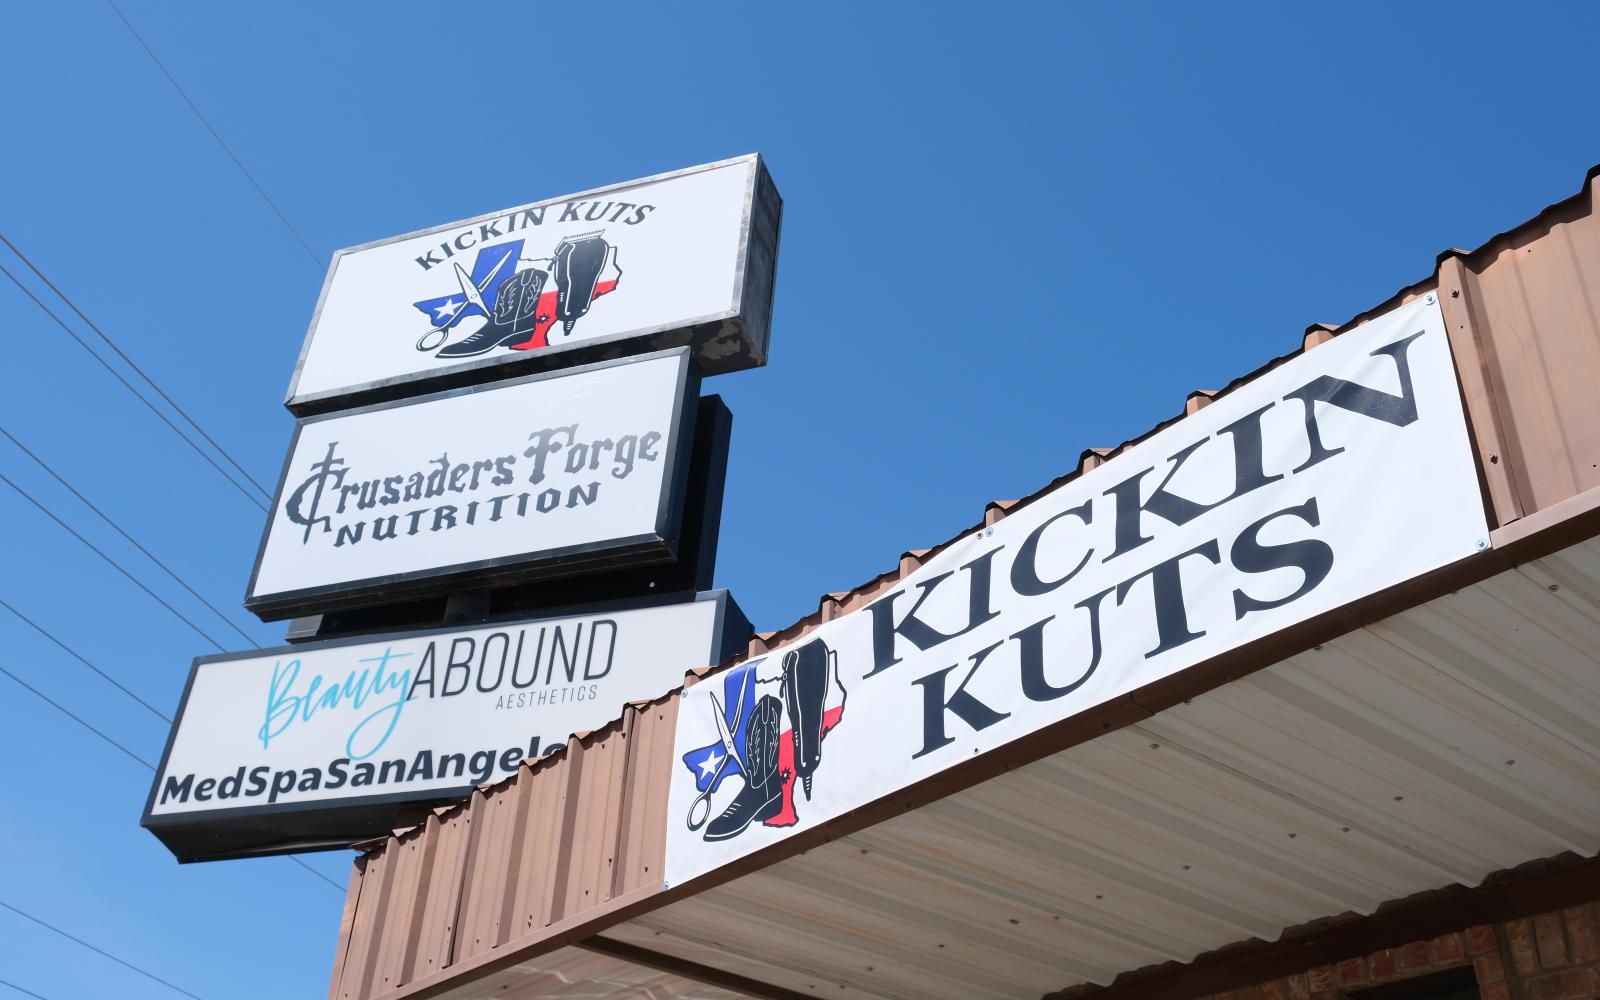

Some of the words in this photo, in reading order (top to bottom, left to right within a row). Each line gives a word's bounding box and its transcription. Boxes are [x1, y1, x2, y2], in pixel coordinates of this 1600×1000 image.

[415, 207, 547, 271] KICKIN
[558, 201, 656, 226] KUTS
[286, 441, 516, 544] Crusaders
[523, 423, 662, 480] Forge
[333, 482, 601, 548] NUTRITION
[862, 330, 1426, 680] KICKIN
[912, 497, 1334, 760] KUTS
[258, 646, 417, 760] Beauty
[407, 619, 618, 700] ABOUND
[495, 684, 598, 710] AESTHETICS
